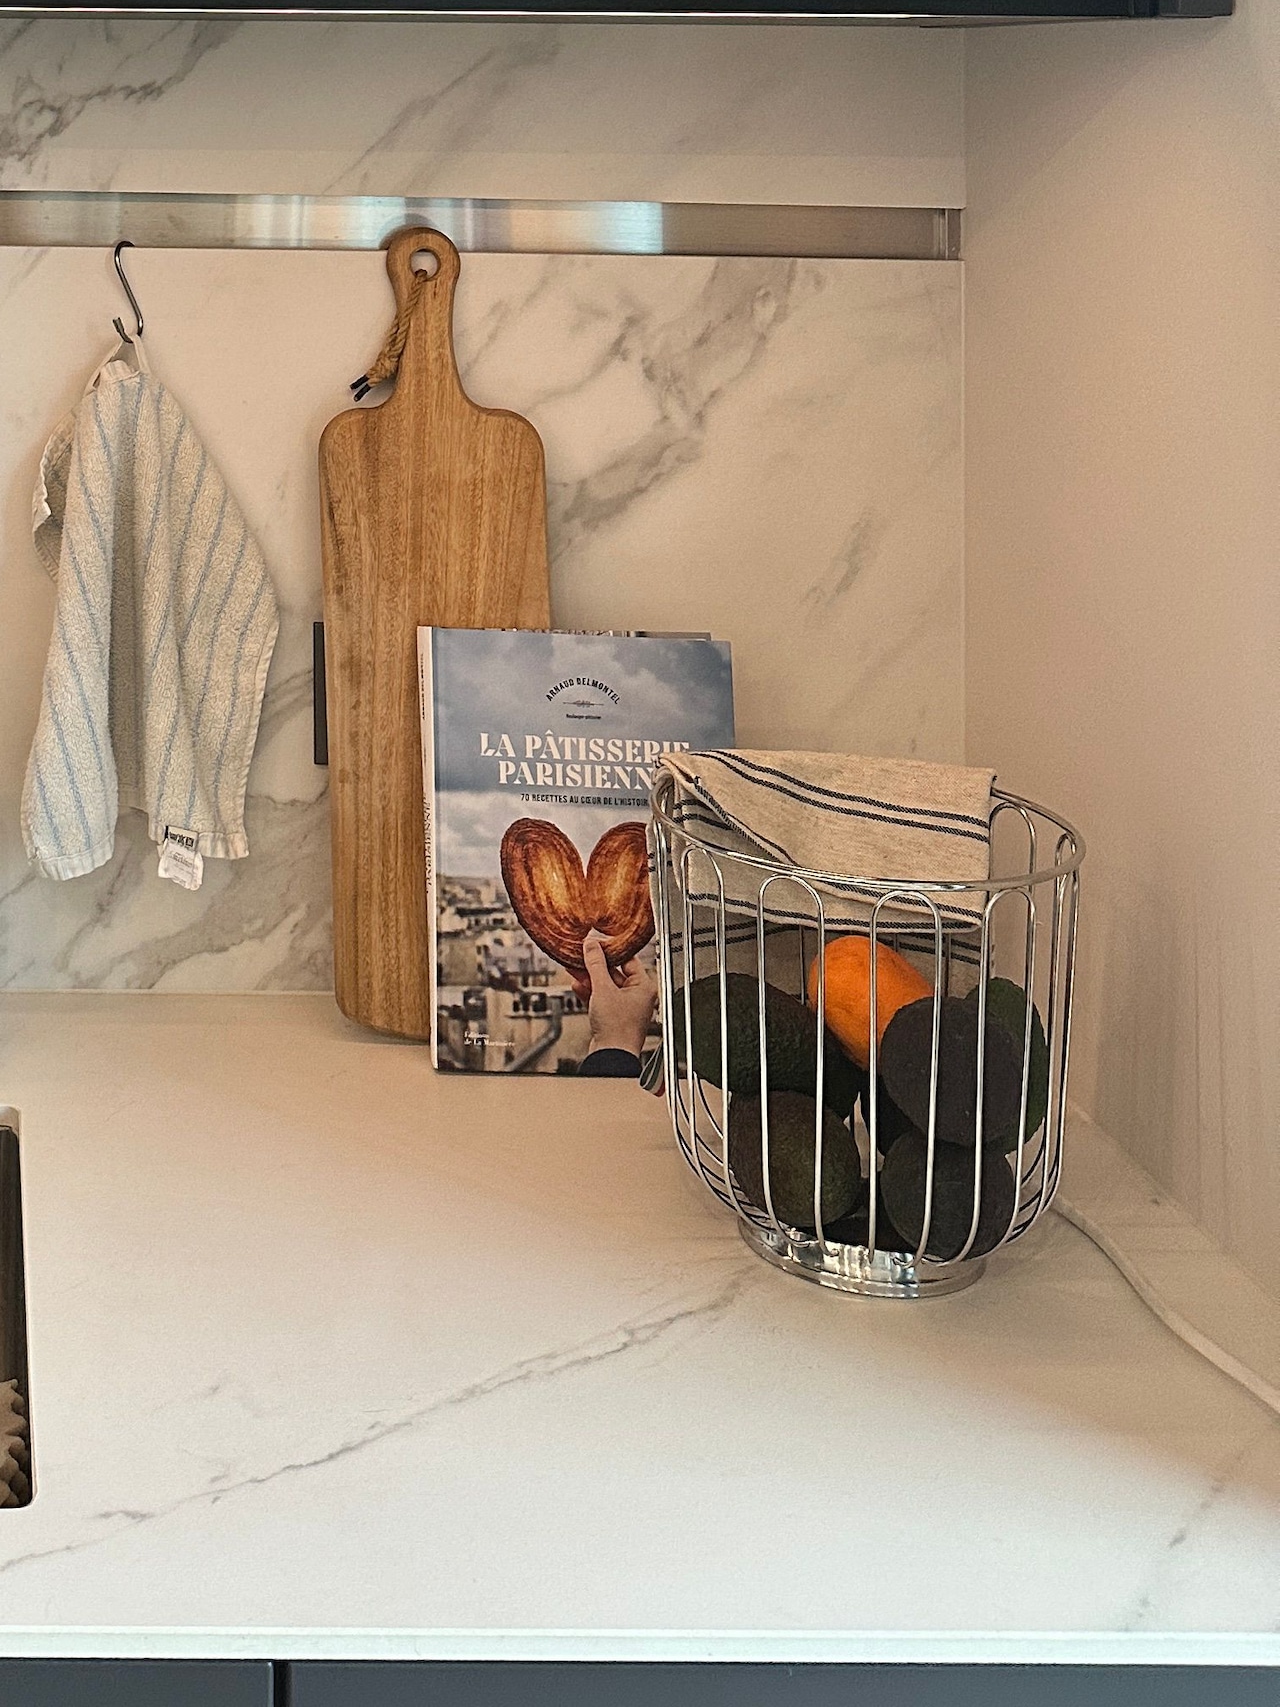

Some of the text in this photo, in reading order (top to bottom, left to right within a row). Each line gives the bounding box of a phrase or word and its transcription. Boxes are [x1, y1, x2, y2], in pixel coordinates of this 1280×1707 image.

[546, 677, 621, 705] ARNAUD DELMONTEL
[480, 732, 516, 758] LA
[498, 760, 655, 791] PARISIENN
[520, 793, 530, 802] 70
[531, 794, 568, 804] RECETTES
[569, 795, 579, 804] AU
[603, 796, 613, 806] DE
